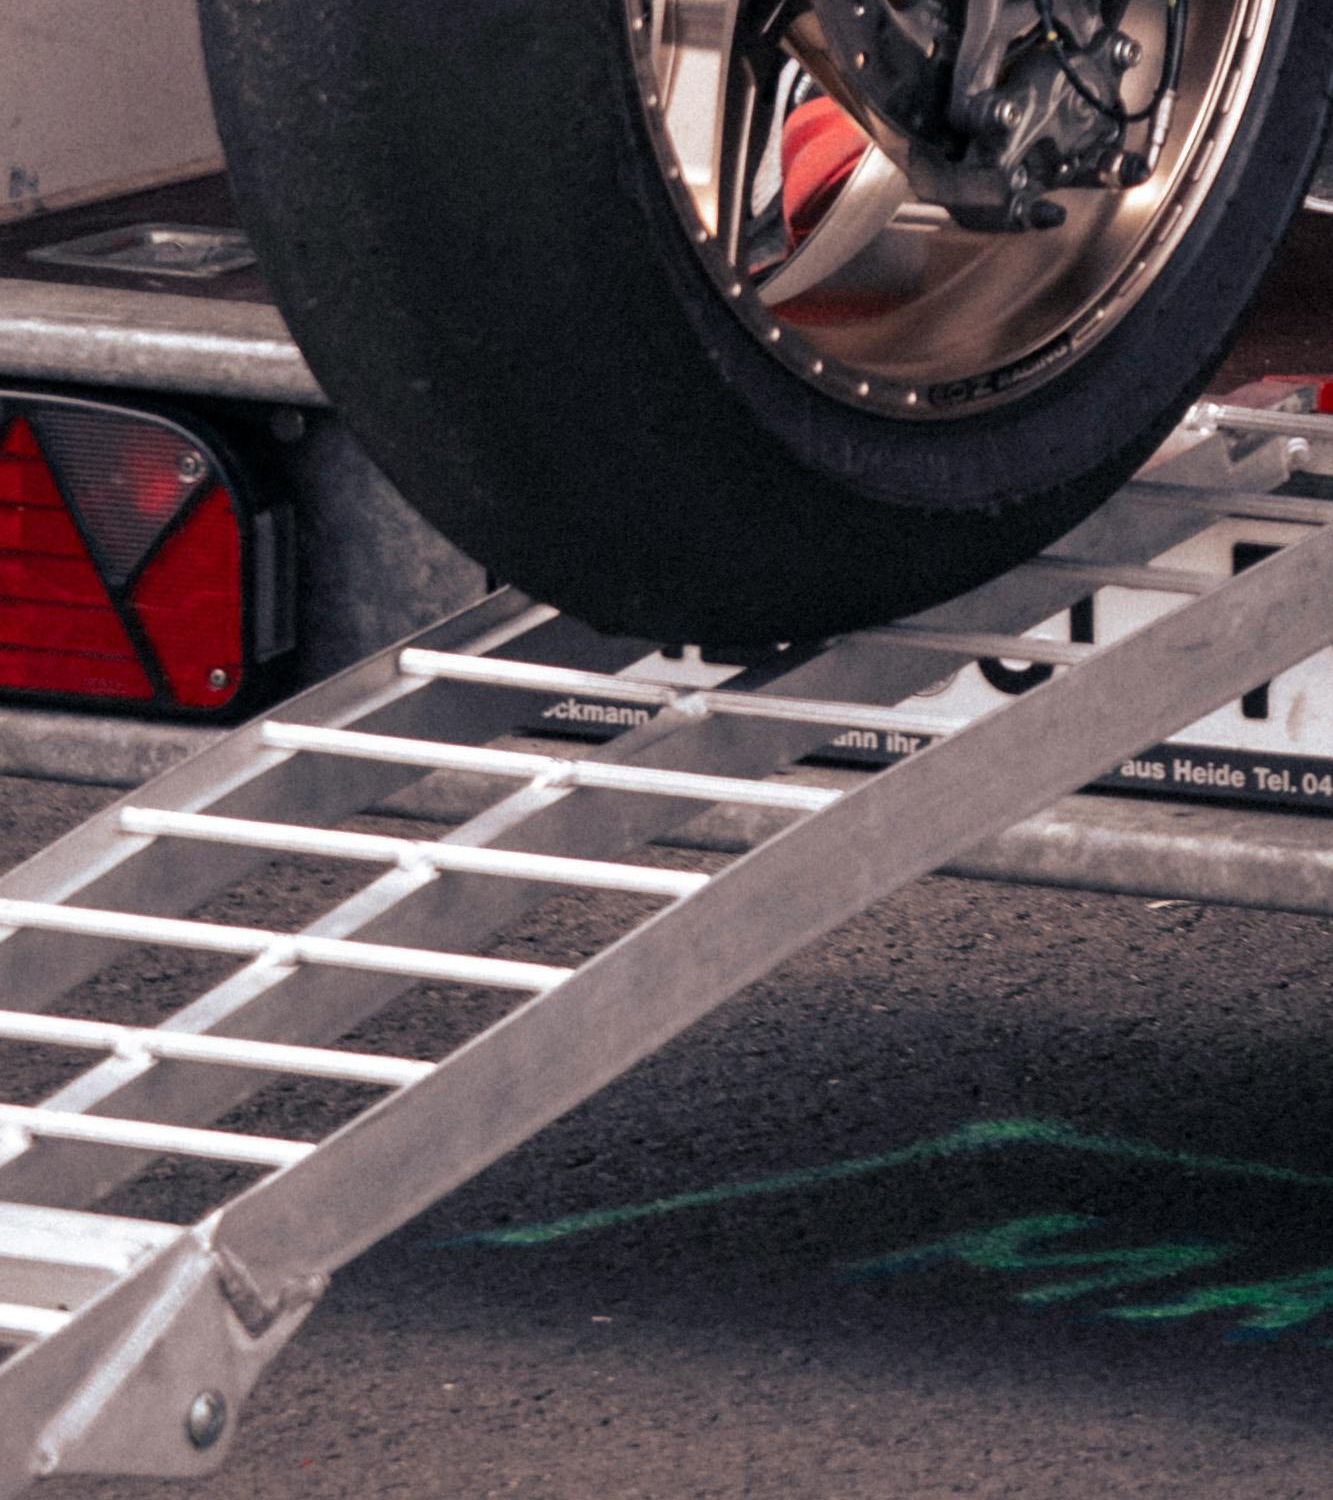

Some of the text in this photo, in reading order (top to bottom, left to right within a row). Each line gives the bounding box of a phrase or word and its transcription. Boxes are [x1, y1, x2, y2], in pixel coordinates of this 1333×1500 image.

[1120, 759, 1165, 781] aus
[1172, 759, 1246, 789] Heide
[1253, 767, 1298, 794] Tel.
